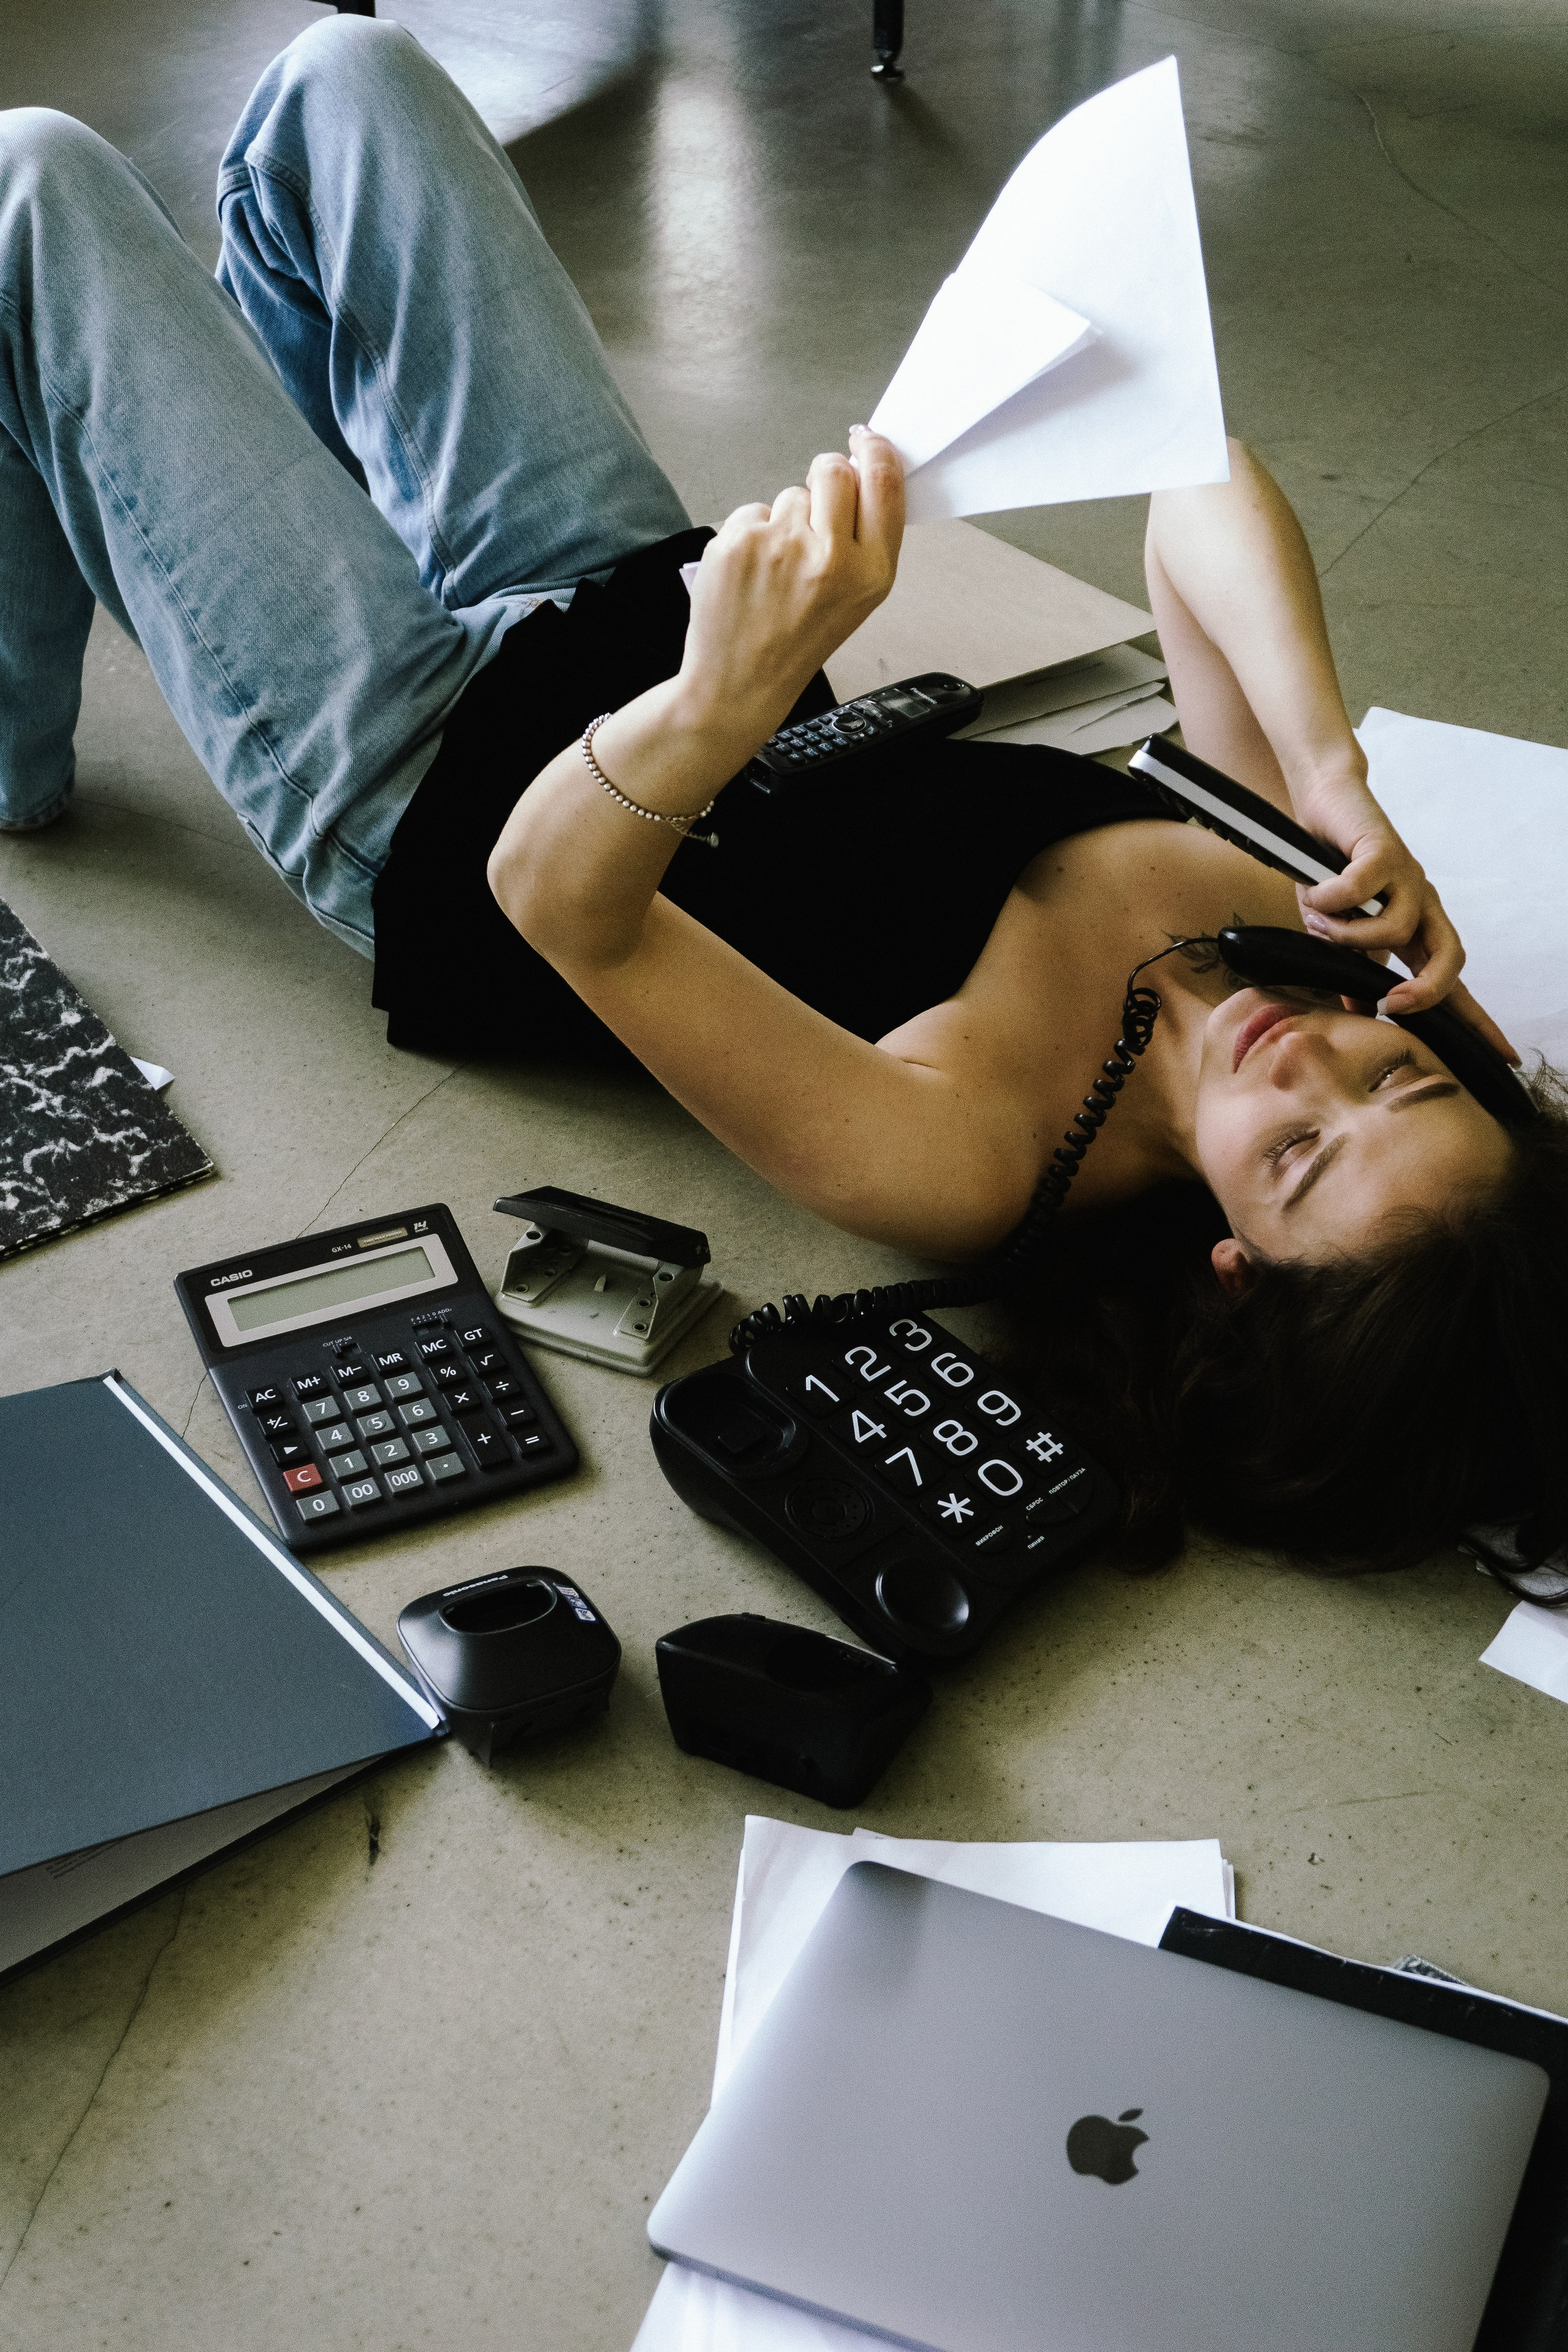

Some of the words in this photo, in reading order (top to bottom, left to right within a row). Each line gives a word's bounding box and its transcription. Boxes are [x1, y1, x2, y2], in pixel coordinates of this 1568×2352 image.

[910, 687, 937, 704] Panasonic
[413, 1221, 426, 1230] 14
[331, 1243, 352, 1253] GX-14
[210, 1269, 253, 1287] CASIO
[464, 1328, 482, 1340] GT
[889, 1319, 932, 1351] 3
[421, 1339, 447, 1354] MC
[379, 1352, 403, 1366] MR
[845, 1346, 892, 1382] 2
[930, 1352, 974, 1387] 6
[296, 1376, 321, 1390] M+
[398, 1379, 410, 1390] 9
[805, 1374, 840, 1403] 1
[255, 1389, 276, 1403] AC
[357, 1390, 370, 1402] 8
[883, 1379, 931, 1417] 5
[315, 1401, 326, 1414] 7
[412, 1404, 424, 1417] 6
[977, 1390, 1022, 1426] 9
[370, 1417, 383, 1430] 5
[851, 1409, 887, 1443] 4
[331, 1429, 343, 1441] 4
[425, 1432, 438, 1445] 3
[933, 1419, 978, 1456] 8
[384, 1444, 398, 1457] 2
[344, 1457, 354, 1468] 1
[884, 1447, 922, 1487] 7
[296, 1470, 312, 1483] C
[391, 1470, 418, 1487] 000
[978, 1459, 1023, 1496] 0
[352, 1483, 374, 1499] 00
[312, 1499, 325, 1512] 0
[1026, 1497, 1043, 1510] СБРОС
[975, 1525, 1003, 1546] МИКРОФОН
[442, 1575, 508, 1597] Panasonic
